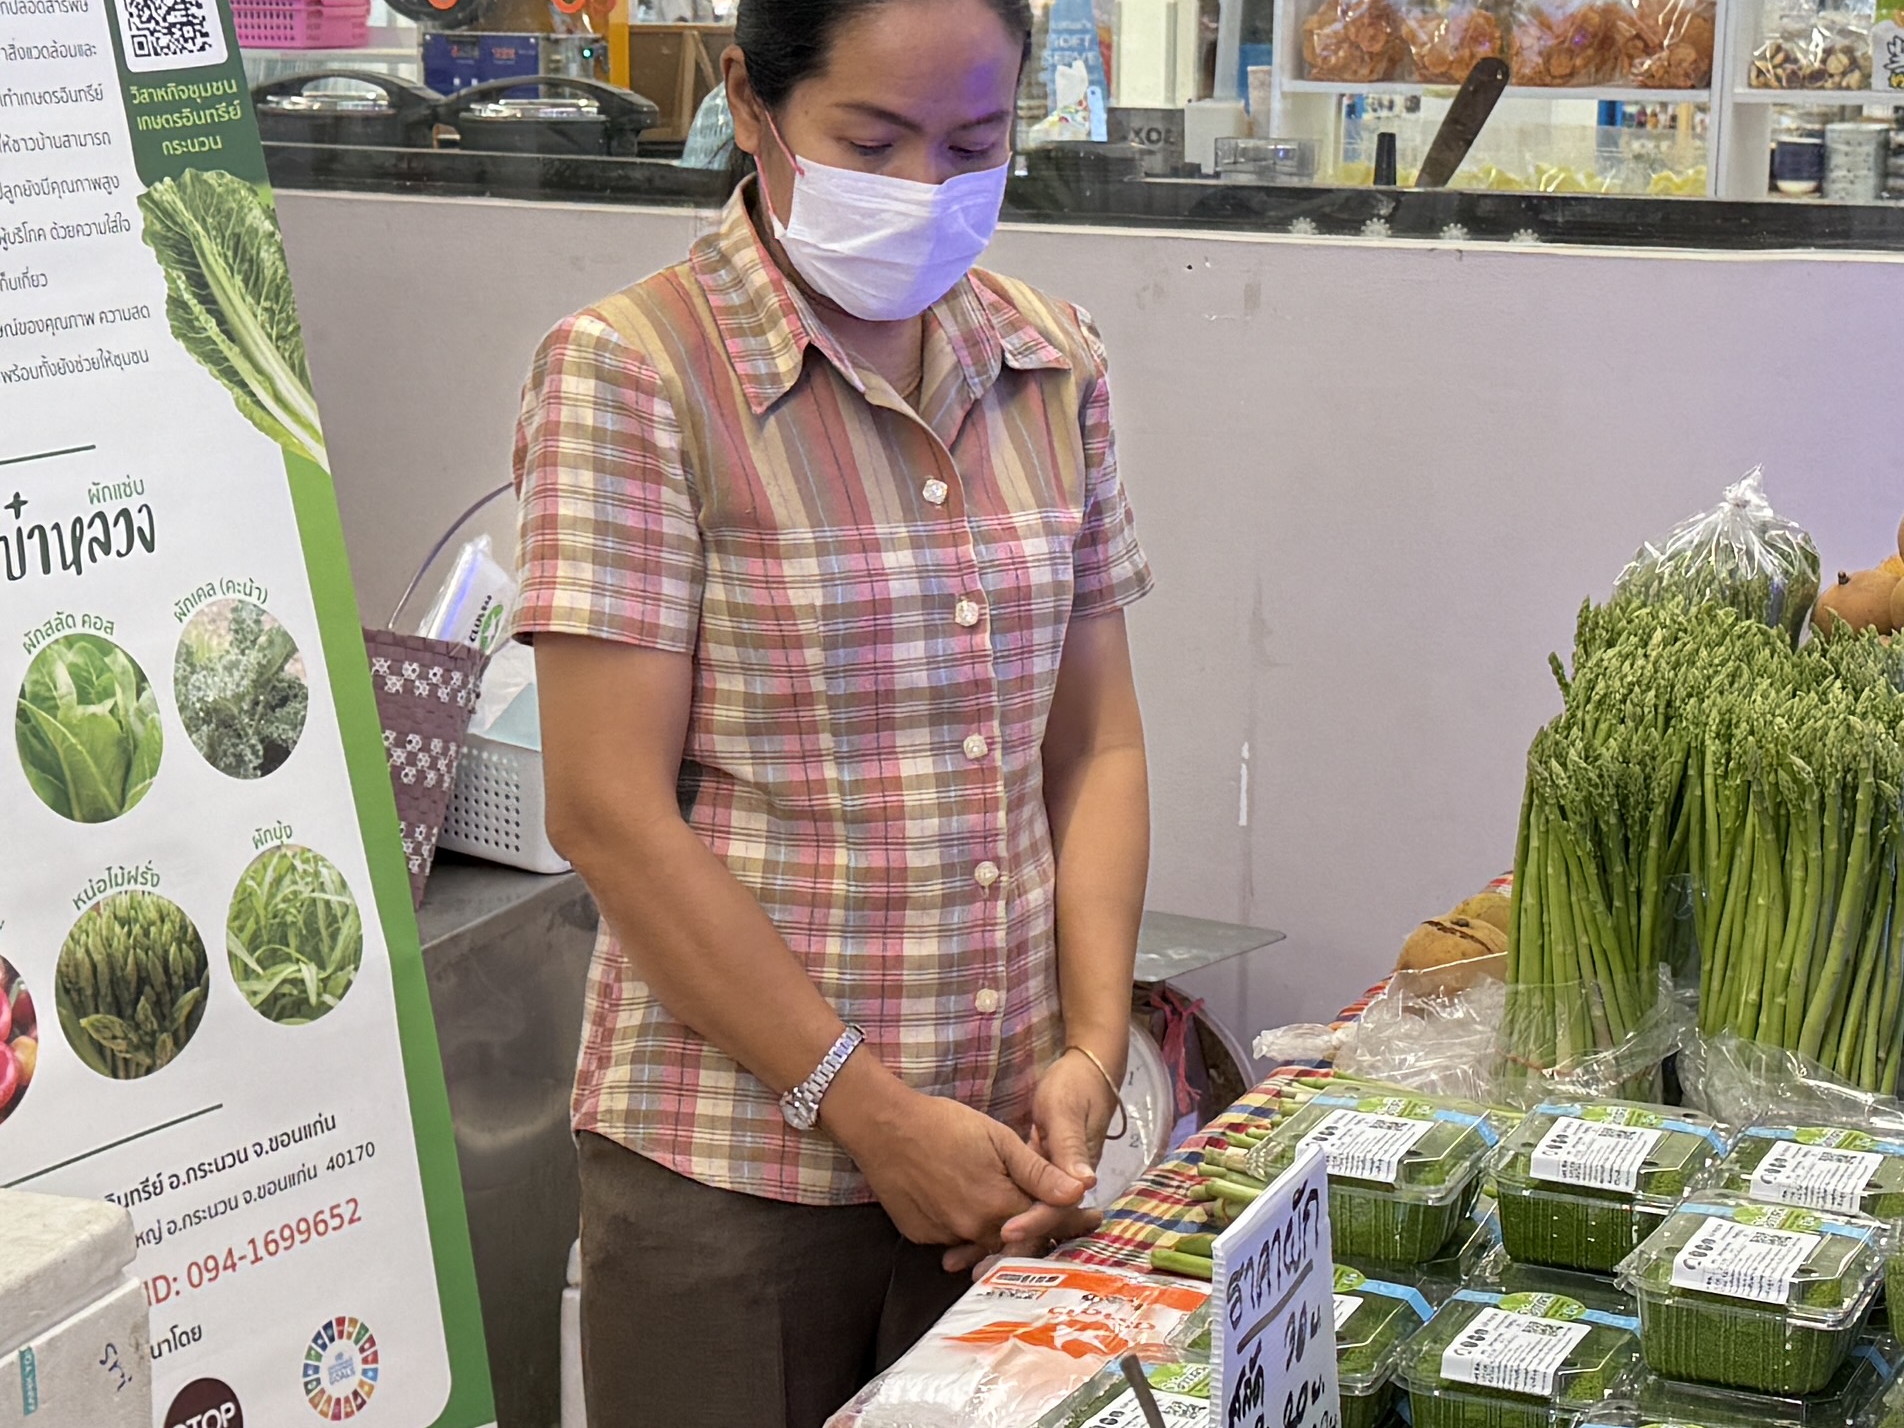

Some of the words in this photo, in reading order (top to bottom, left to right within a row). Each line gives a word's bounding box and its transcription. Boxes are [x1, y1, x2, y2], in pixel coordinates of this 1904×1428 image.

[130, 78, 237, 105] วิสาหกิจชุมชน
[137, 100, 242, 130] เกษตรอินทรีย์
[162, 133, 222, 156] กระนวน
[99, 303, 151, 324] ความสด
[87, 475, 145, 505] ผักแซ่บ
[22, 611, 77, 656] ผักสลัด
[81, 612, 116, 636] คอส
[72, 859, 161, 912] หน่อไม้ฝรั่ง
[167, 1146, 249, 1191] อ.กระนวน
[252, 1112, 337, 1158] จ.ขอนแก่น
[167, 1196, 239, 1236] อ.กระนวน
[242, 1163, 318, 1205] จ.ขอนแก่น
[325, 1140, 376, 1172] 40170
[186, 1197, 363, 1290] 094-1699652
